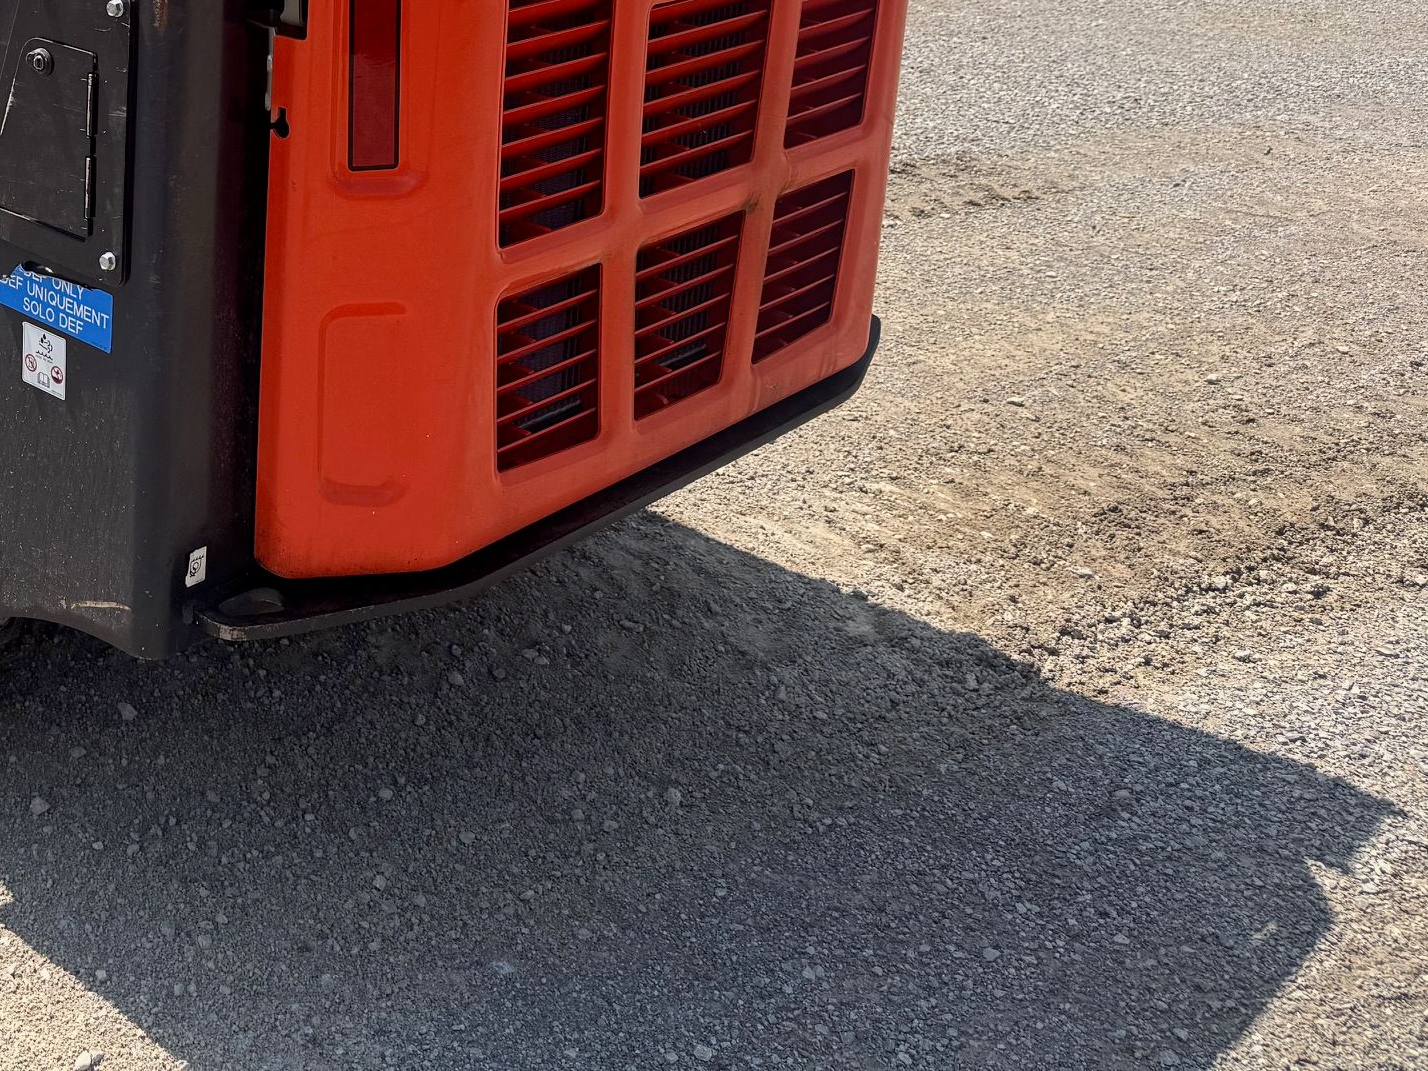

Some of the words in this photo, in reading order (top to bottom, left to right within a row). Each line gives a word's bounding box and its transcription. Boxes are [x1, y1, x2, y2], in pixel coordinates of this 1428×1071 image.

[27, 280, 110, 330] UNIQUEMENT
[52, 277, 85, 300] ONLY
[22, 297, 55, 323] SOLO
[59, 312, 84, 335] DEF
